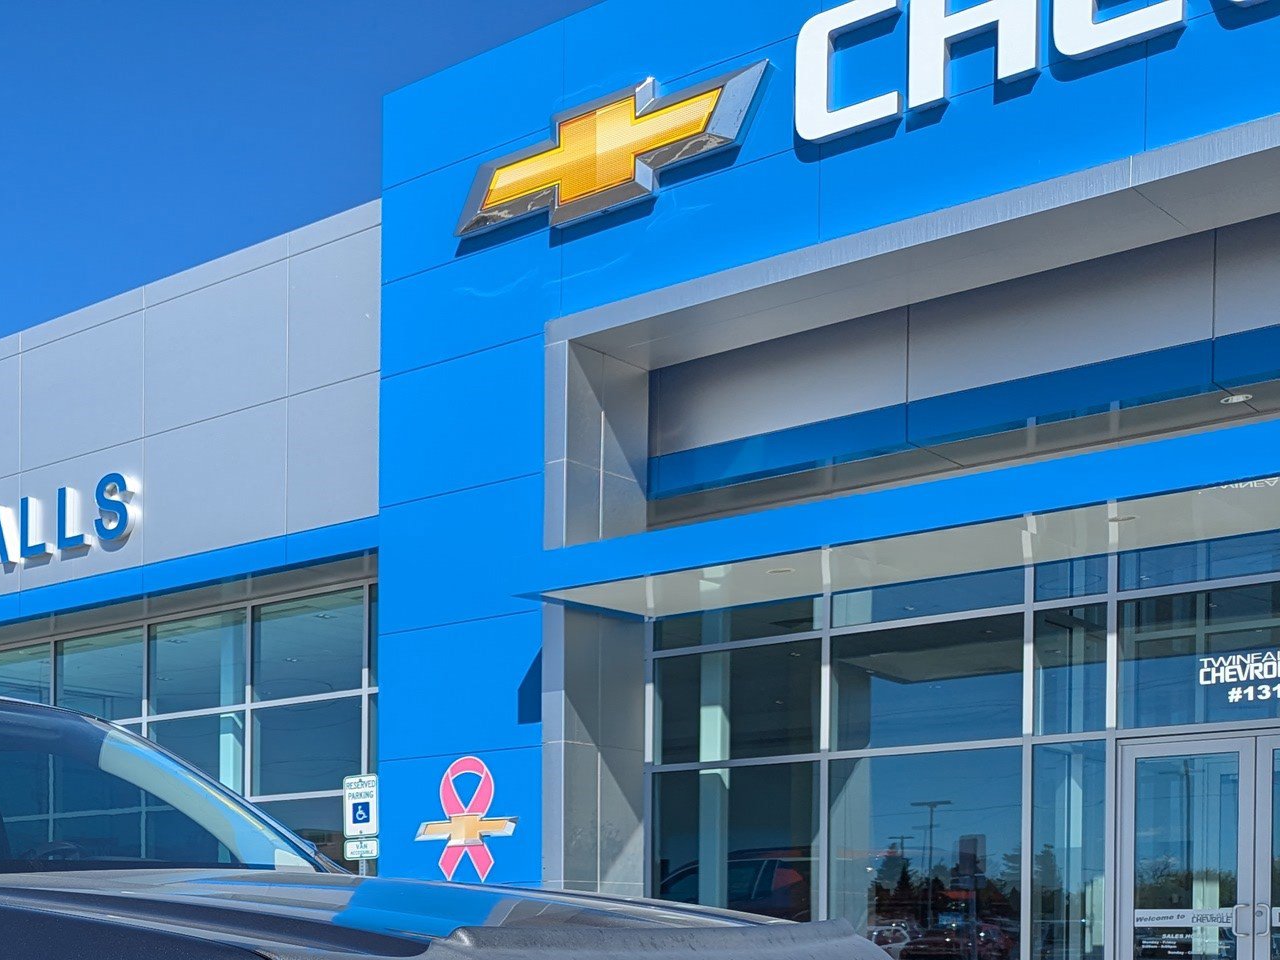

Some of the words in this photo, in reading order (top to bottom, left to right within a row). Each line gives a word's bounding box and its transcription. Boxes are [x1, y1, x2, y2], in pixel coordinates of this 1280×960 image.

[1199, 651, 1280, 669] TWINFA
[1199, 661, 1280, 686] CHEVRO
[345, 779, 375, 790] RESERVED
[348, 790, 374, 799] PARKING
[1136, 914, 1174, 923] Welcome
[1191, 915, 1233, 924] CHEVROLE
